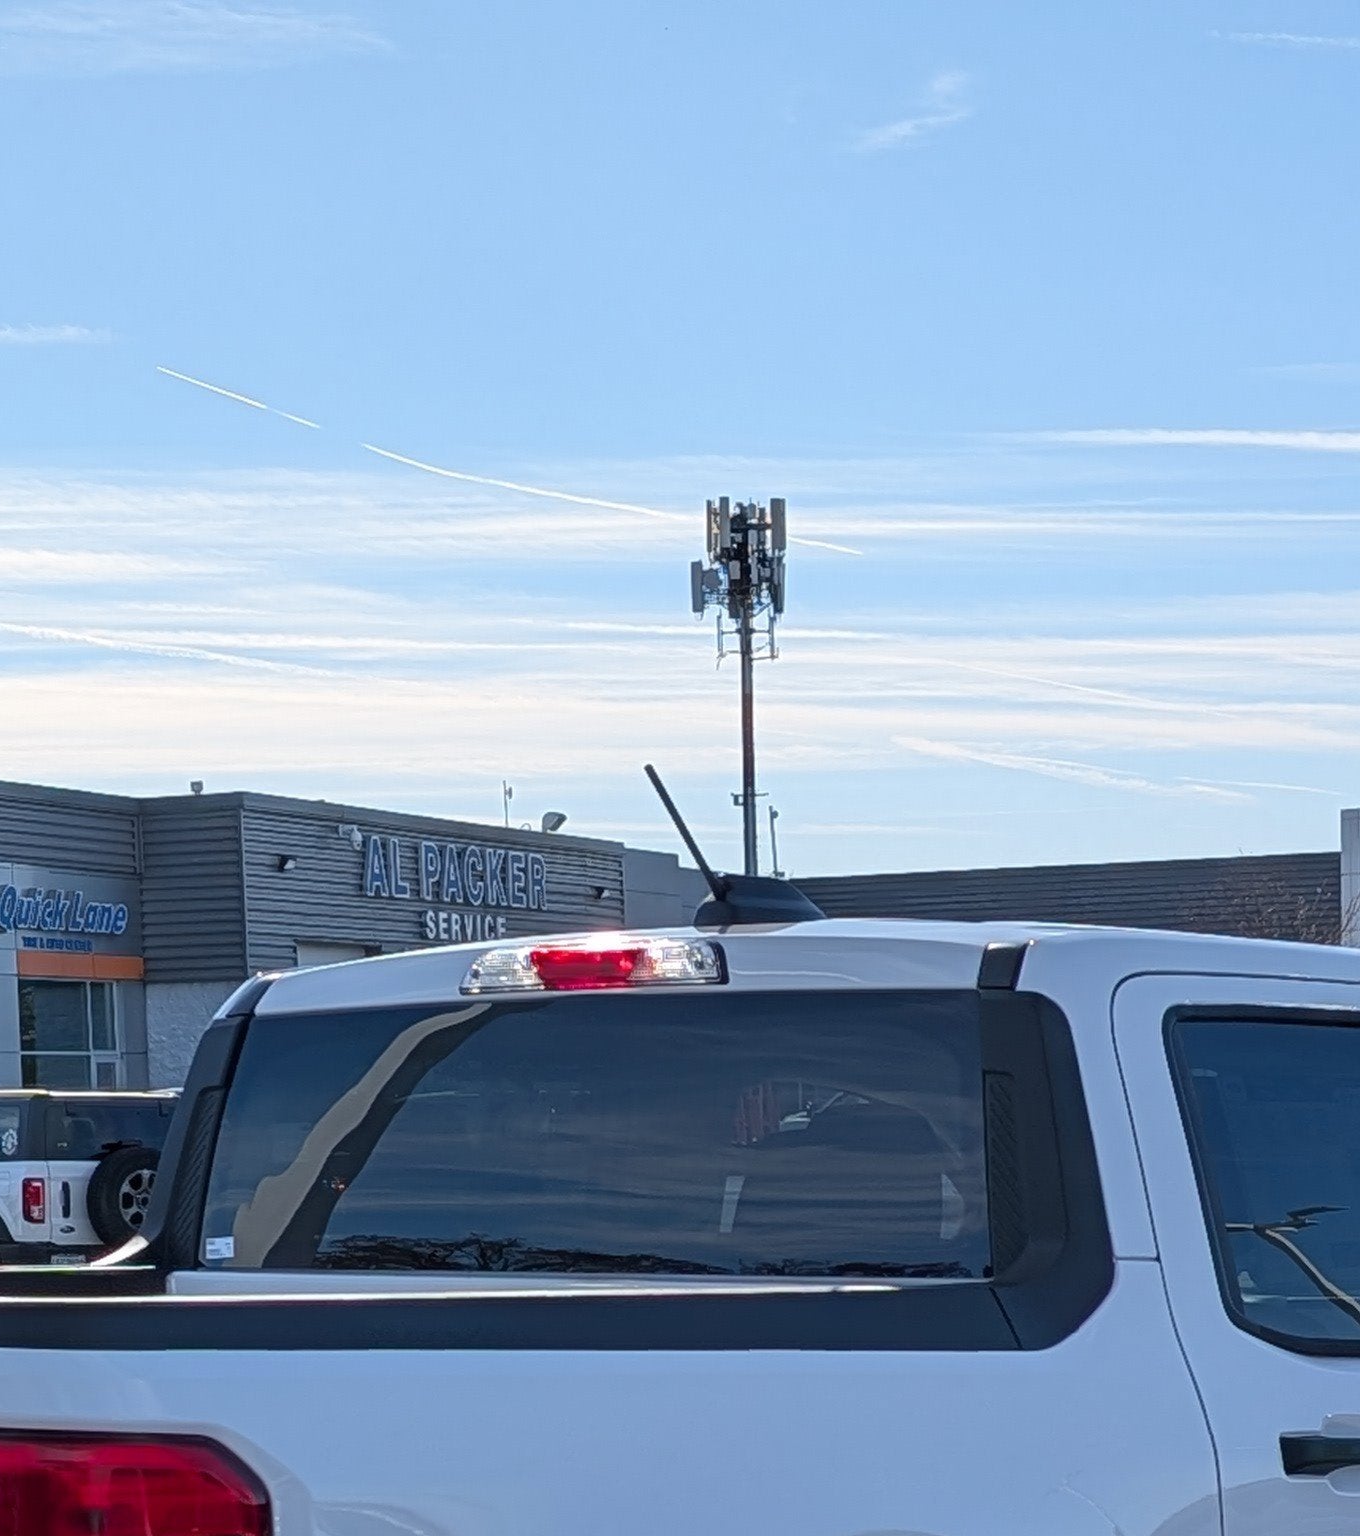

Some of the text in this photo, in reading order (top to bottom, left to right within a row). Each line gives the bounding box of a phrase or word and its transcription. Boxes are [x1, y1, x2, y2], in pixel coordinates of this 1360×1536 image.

[366, 835, 548, 911] AL PACKER
[69, 891, 128, 935] Lane
[426, 910, 507, 940] SERVICE
